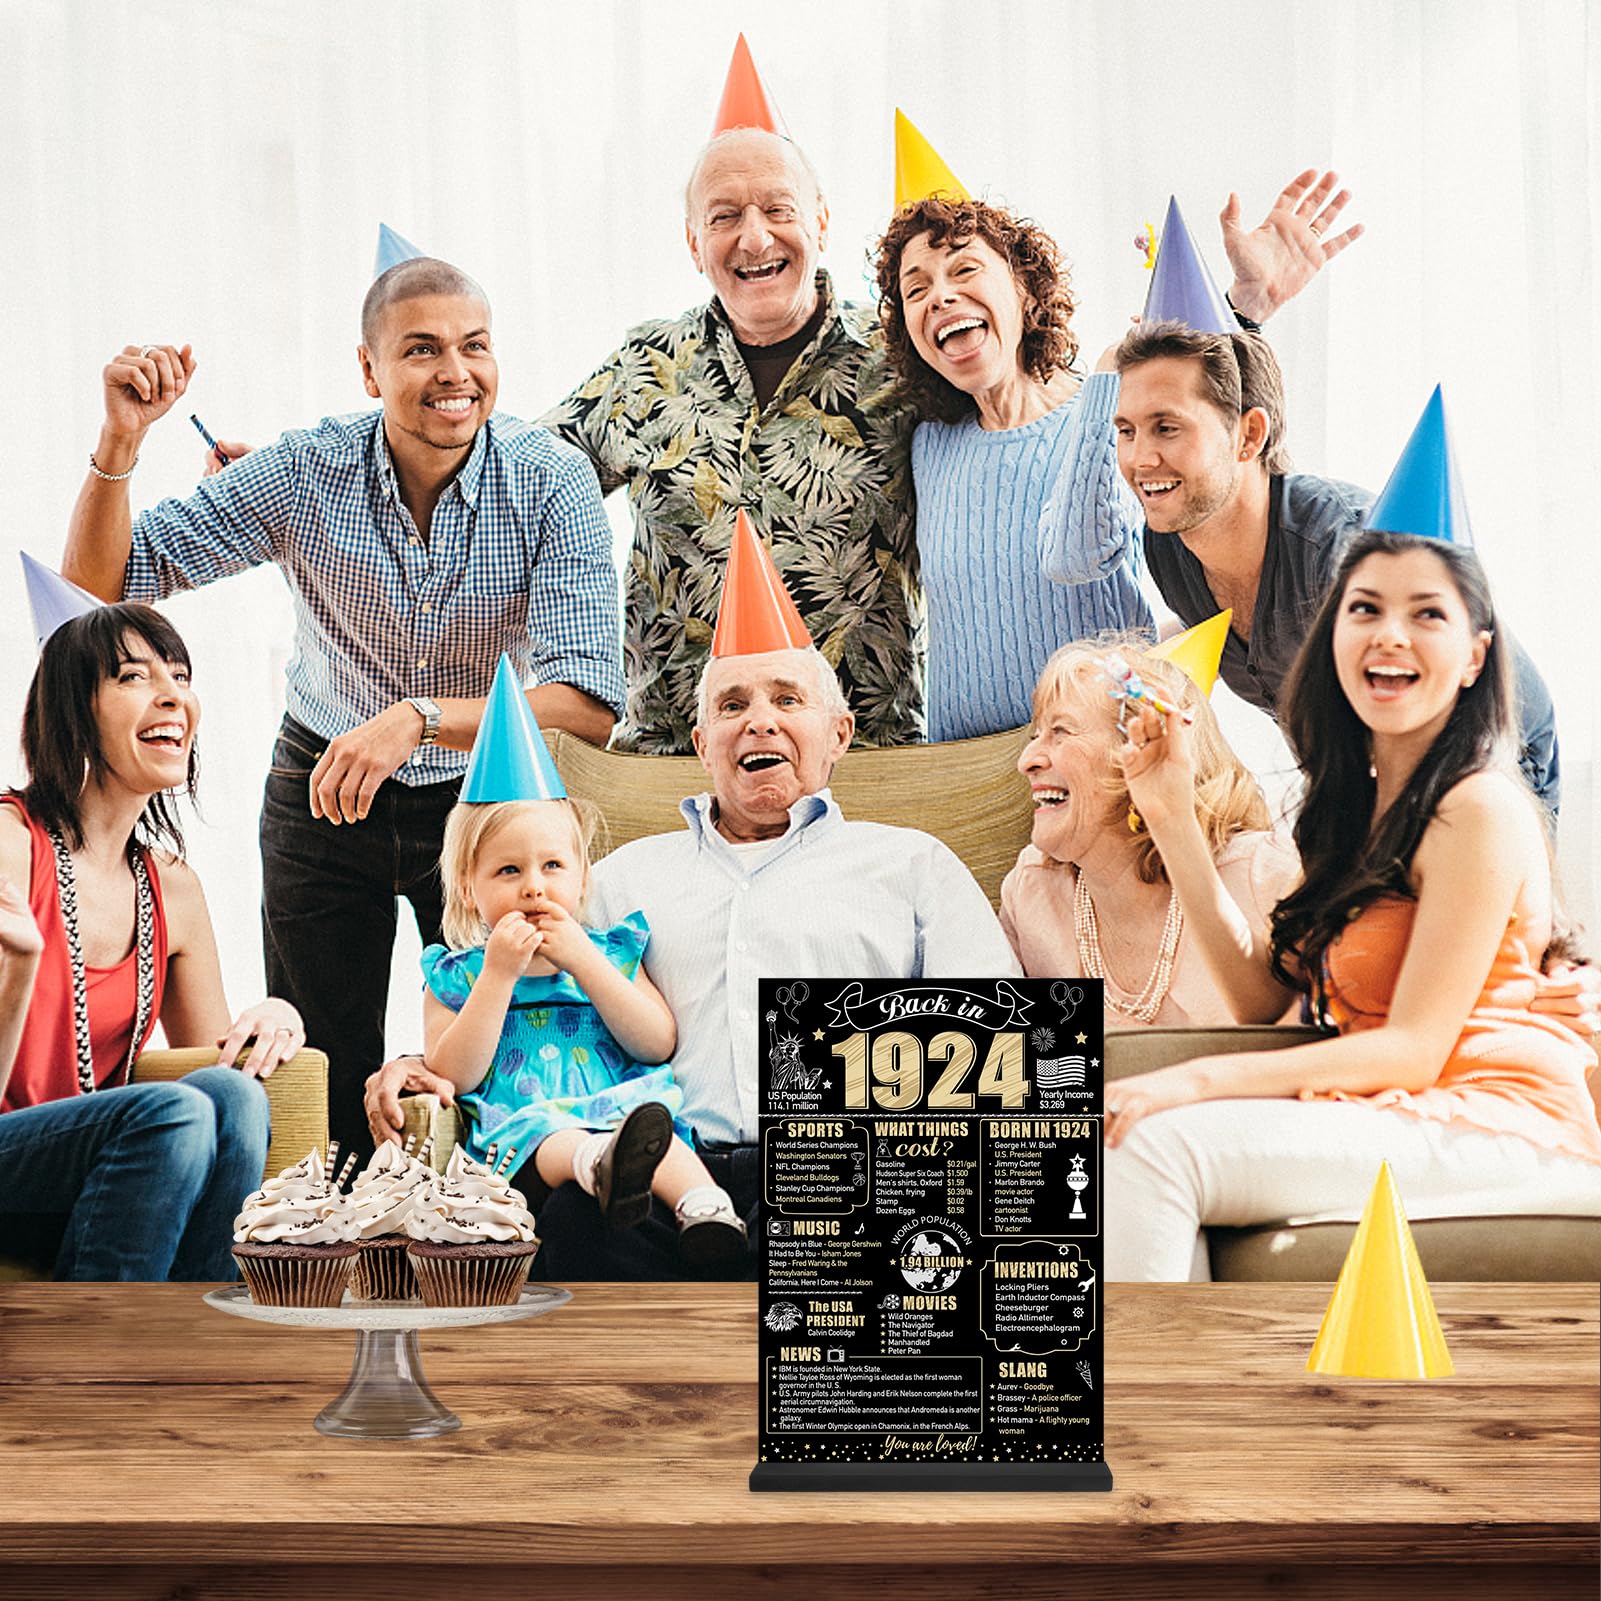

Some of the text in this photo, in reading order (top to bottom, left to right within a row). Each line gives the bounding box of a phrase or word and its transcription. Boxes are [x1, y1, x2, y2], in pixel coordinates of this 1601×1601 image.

[879, 994, 987, 1021] Back in
[832, 1032, 1031, 1111] 1924
[782, 1092, 822, 1102] Population
[1040, 1090, 1094, 1100] Yearly Income
[769, 1102, 818, 1110] 114.1 million
[788, 1123, 843, 1137] SPORTS
[875, 1122, 969, 1136] WHAT THINGS
[990, 1122, 1090, 1138] BORN IN 1924
[820, 1142, 858, 1150] Champions
[776, 1153, 816, 1161] Washington
[792, 1163, 830, 1171] Champions
[810, 1174, 839, 1182] Bulldogs
[899, 1170, 916, 1178] Super
[776, 1185, 854, 1193] Stanley Cup Champions
[906, 1189, 925, 1197] frying
[876, 1198, 898, 1206] Stamp
[899, 1207, 915, 1215] Eggs
[794, 1221, 840, 1236] MUSIC
[891, 1215, 973, 1245] WORLD POPULATION
[900, 1257, 964, 1267] 1.94 BILLION
[995, 1262, 1079, 1278] INVENTIONS
[996, 1283, 1025, 1292] Locking
[1050, 1294, 1085, 1302] Compass
[809, 1301, 853, 1312] The USA
[903, 1296, 957, 1310] MOVIES
[996, 1304, 1049, 1313] Cheeseburger
[807, 1316, 865, 1326] PRESIDENT
[905, 1313, 933, 1321] Oranges
[902, 1322, 935, 1330] Navigator
[996, 1324, 1080, 1333] Electroencephalogram
[828, 1329, 855, 1338] Coolidge
[781, 1347, 821, 1362] NEWS
[999, 1362, 1047, 1378] SLANG
[1024, 1383, 1054, 1392] Goodbye
[997, 1394, 1026, 1403] Brassey
[1039, 1394, 1059, 1403] police
[1024, 1405, 1059, 1414] Marijuana
[997, 1416, 1009, 1424] Hot
[1046, 1416, 1067, 1425] flighty
[1068, 1417, 1090, 1425] young
[885, 1433, 978, 1456] You are loved!
